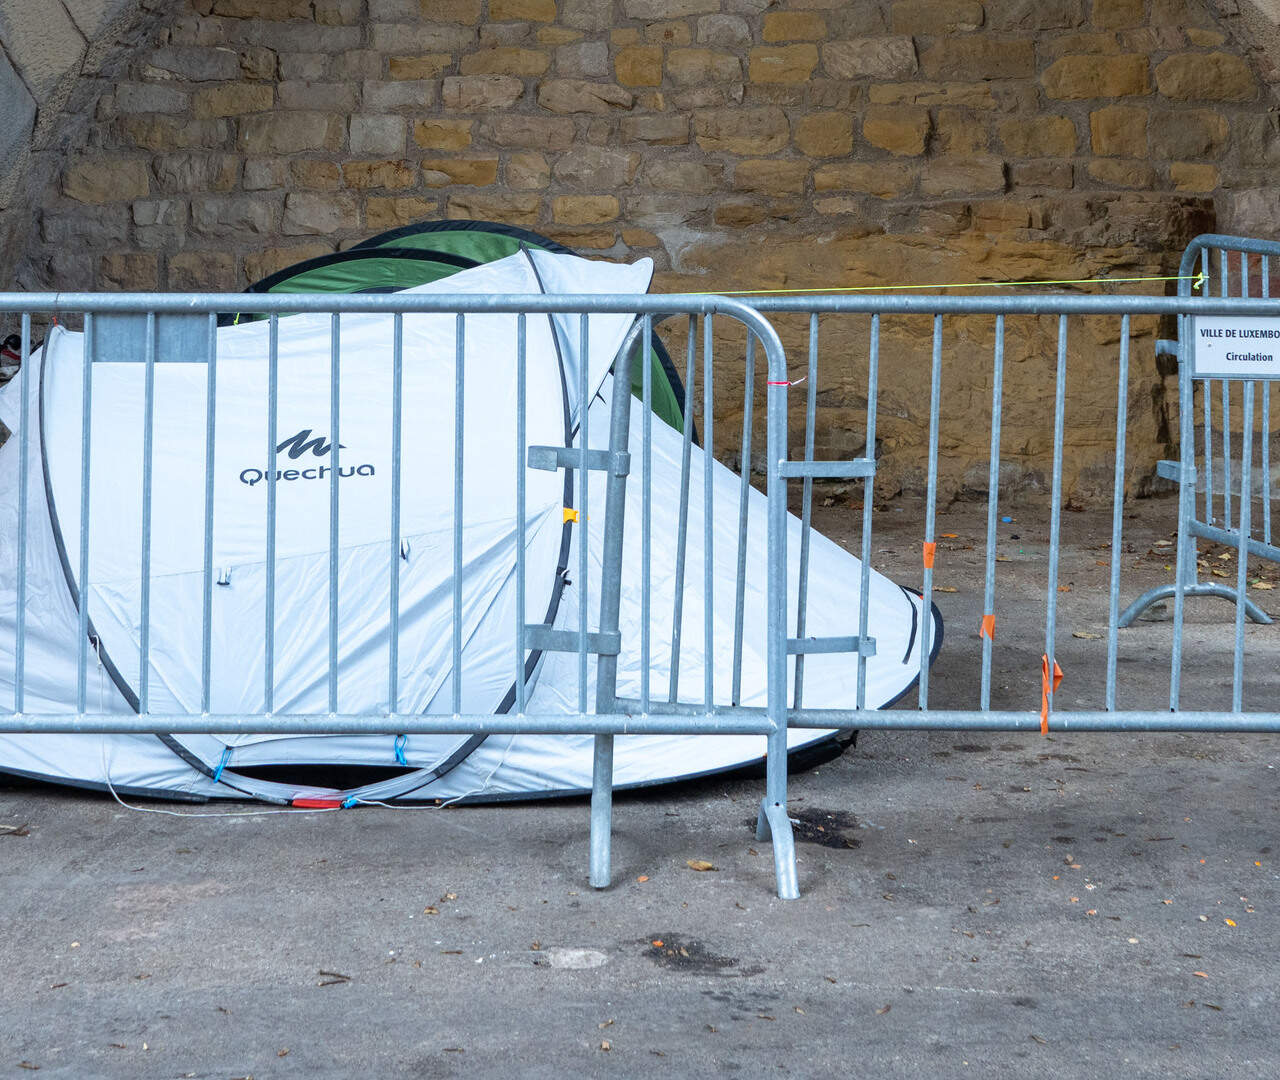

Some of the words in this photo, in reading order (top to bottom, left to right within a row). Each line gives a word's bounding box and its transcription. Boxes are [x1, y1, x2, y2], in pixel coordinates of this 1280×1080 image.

[1200, 328, 1223, 338] VILLE
[1225, 329, 1237, 338] DE
[1226, 352, 1273, 361] Circulation
[239, 464, 376, 487] Quechua
